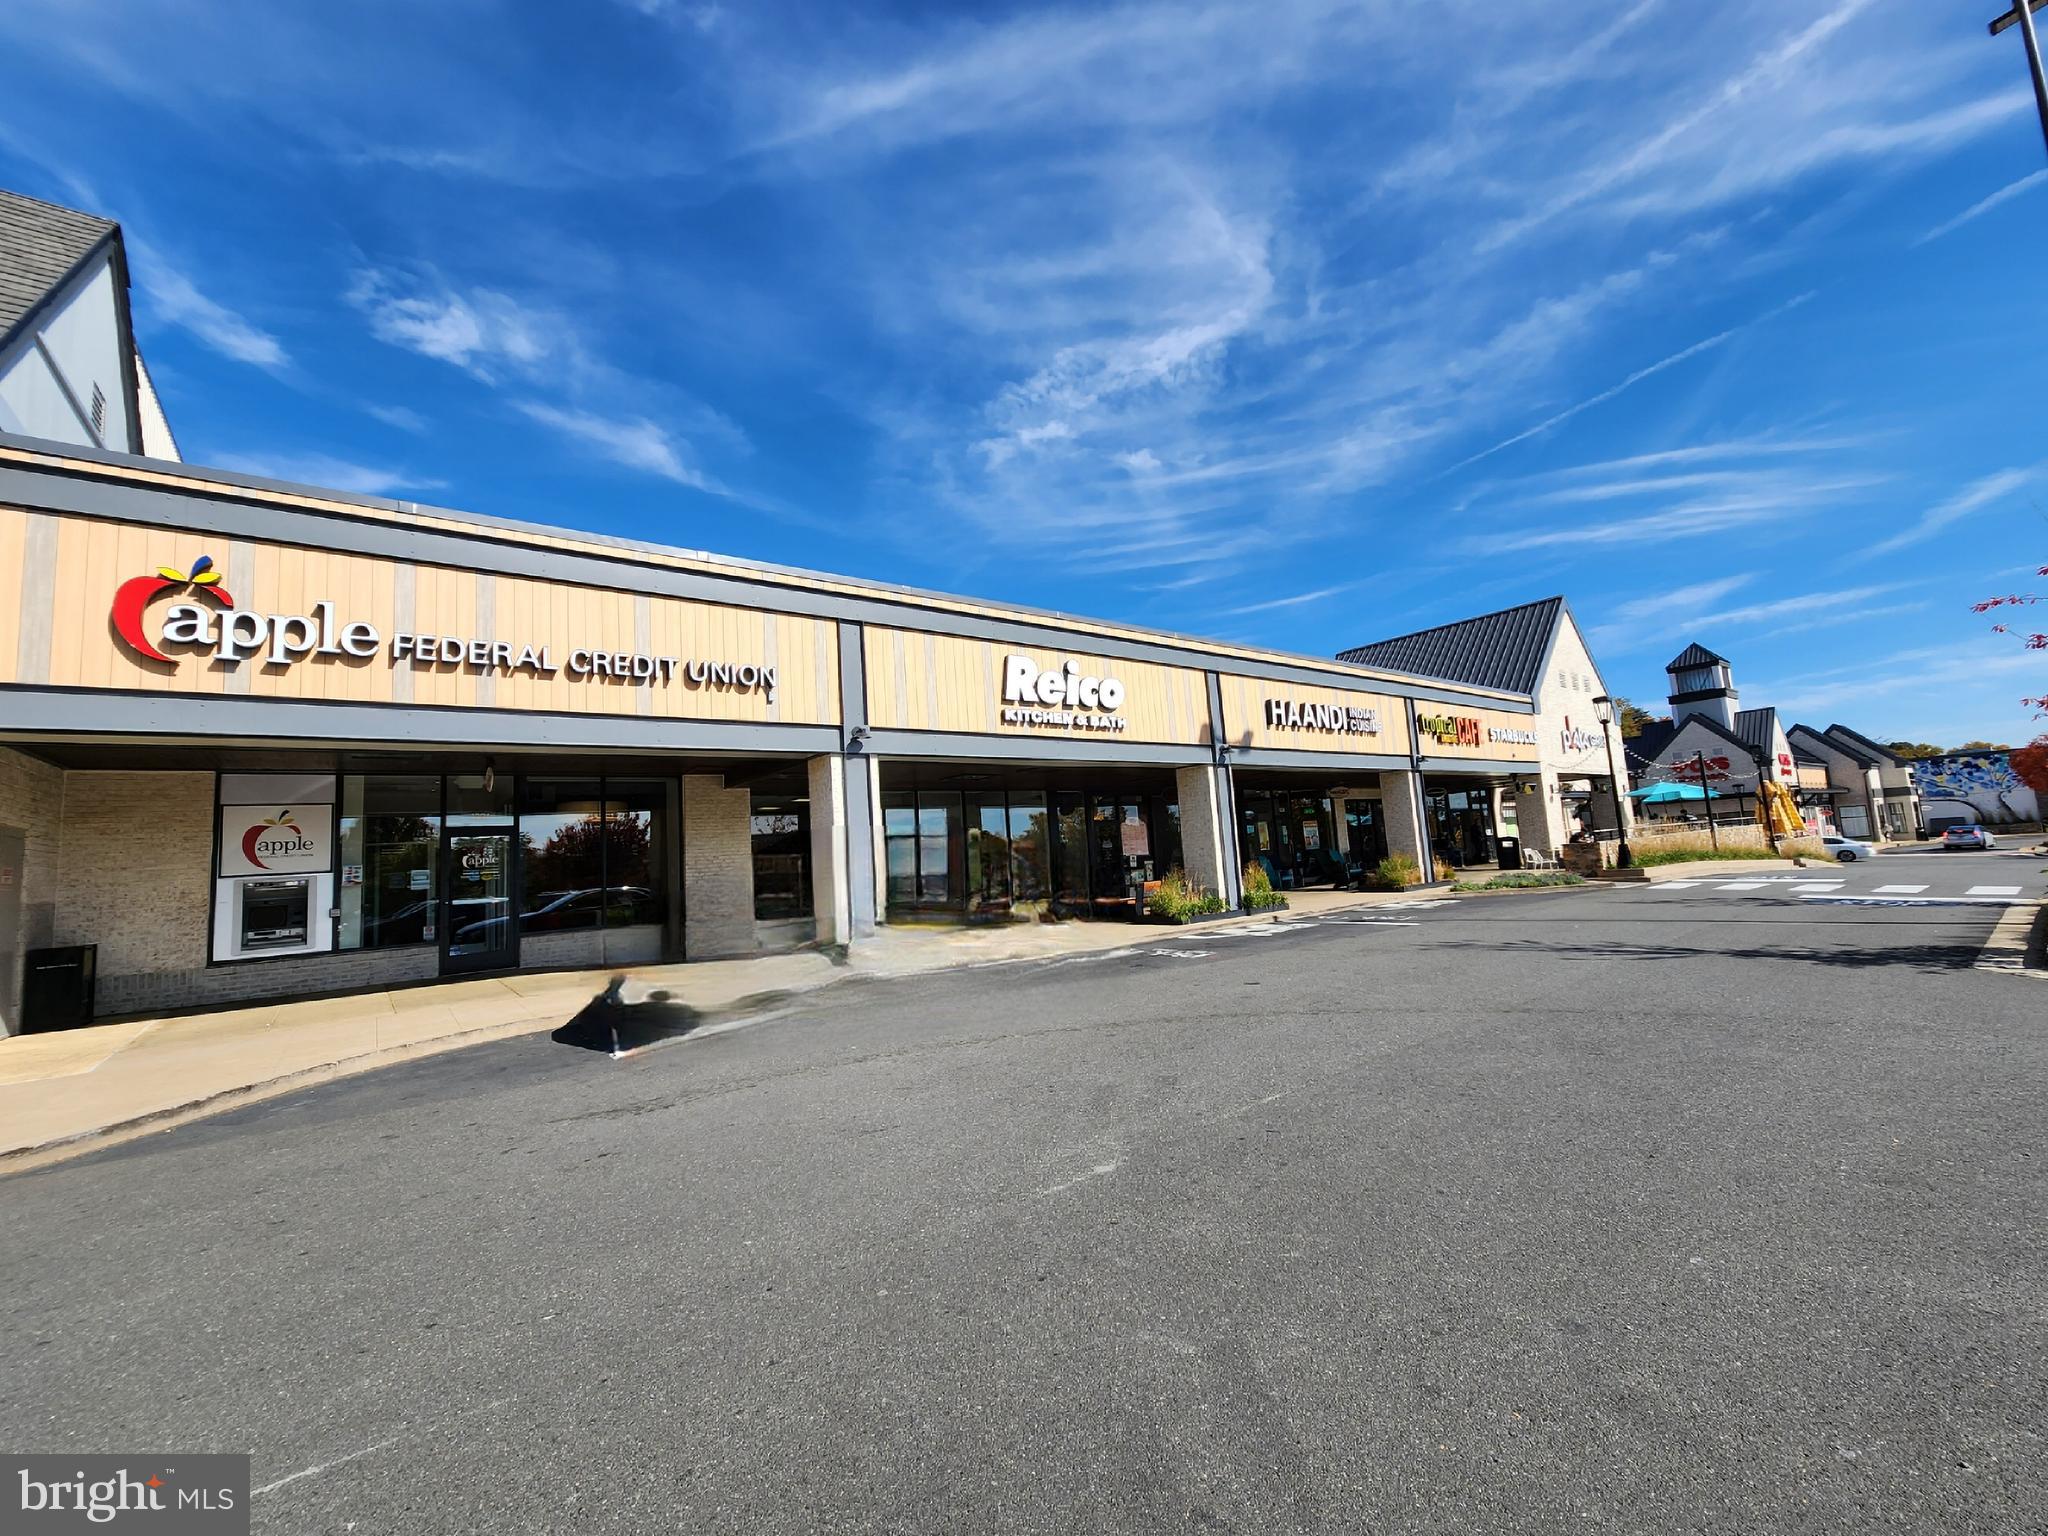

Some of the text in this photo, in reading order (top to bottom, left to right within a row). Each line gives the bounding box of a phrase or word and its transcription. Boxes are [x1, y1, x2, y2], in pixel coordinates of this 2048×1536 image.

[163, 600, 776, 687] apple FEDERAL CREDIT UNION
[1005, 654, 1125, 709] Reico
[1004, 709, 1127, 728] KITCHEN & BATH
[1271, 699, 1348, 730] HAANDI
[1349, 707, 1377, 720] INDIAN
[1350, 719, 1383, 733] CUISINE
[257, 836, 314, 855] apple
[467, 854, 499, 868] apple
